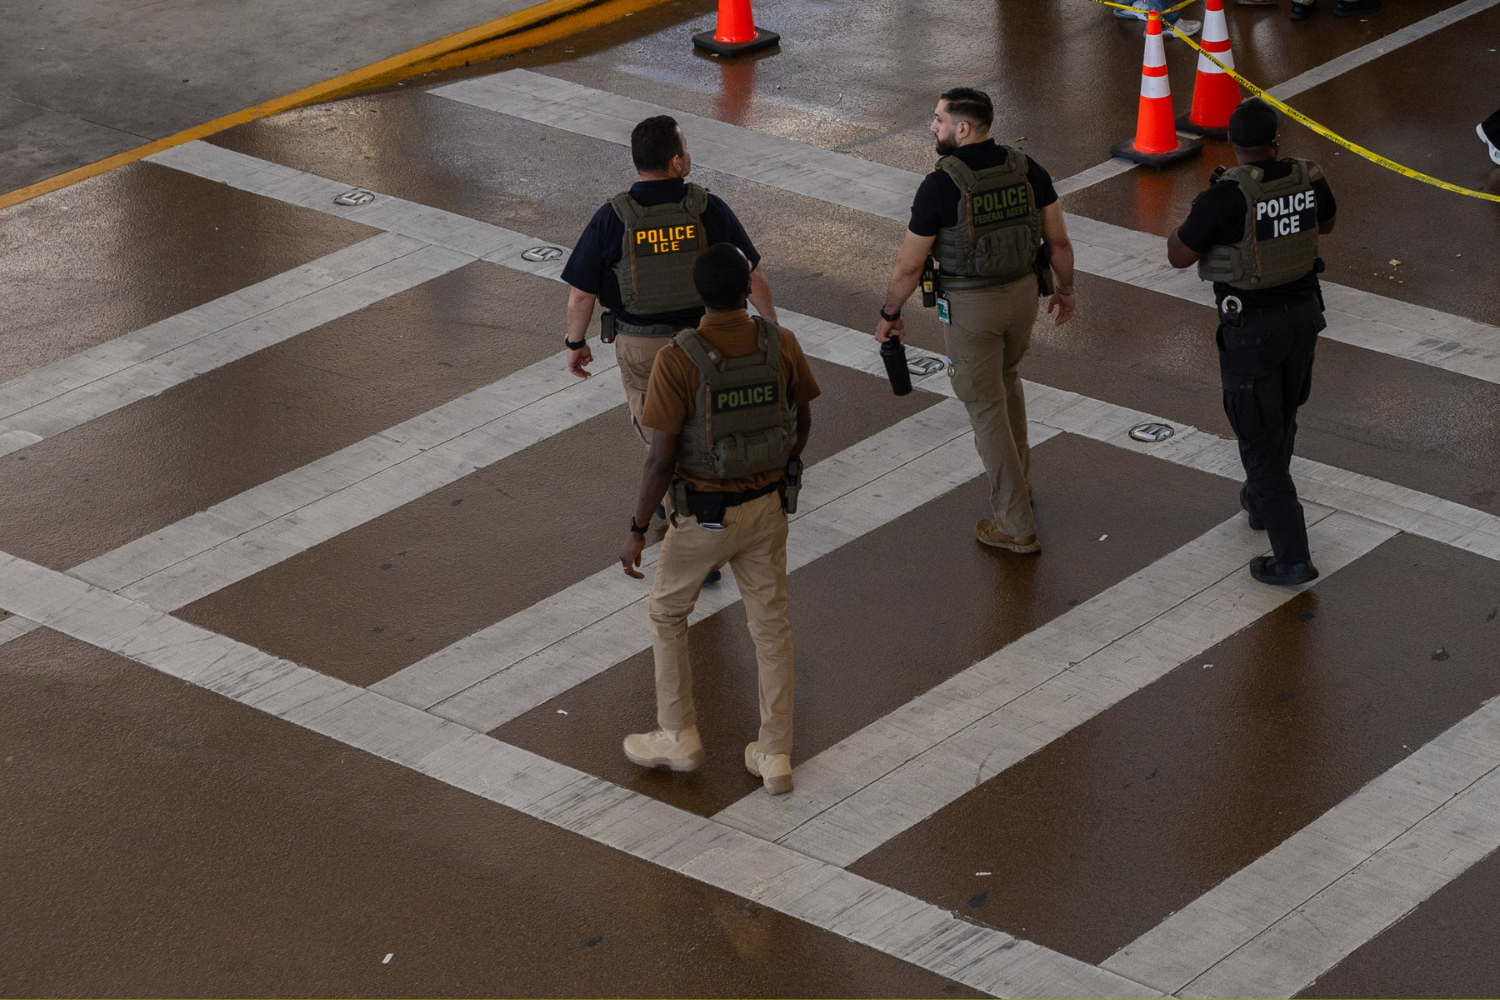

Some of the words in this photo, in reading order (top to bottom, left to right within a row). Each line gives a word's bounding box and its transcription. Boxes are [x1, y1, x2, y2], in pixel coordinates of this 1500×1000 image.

[972, 185, 1027, 215] POLICE
[1256, 189, 1315, 221] POLICE
[974, 210, 1005, 225] FEDERAL
[1006, 204, 1028, 219] AGENT
[1273, 214, 1300, 238] ICE
[636, 225, 696, 245] POLICE
[653, 241, 680, 253] ICE
[717, 385, 774, 409] POLICE
